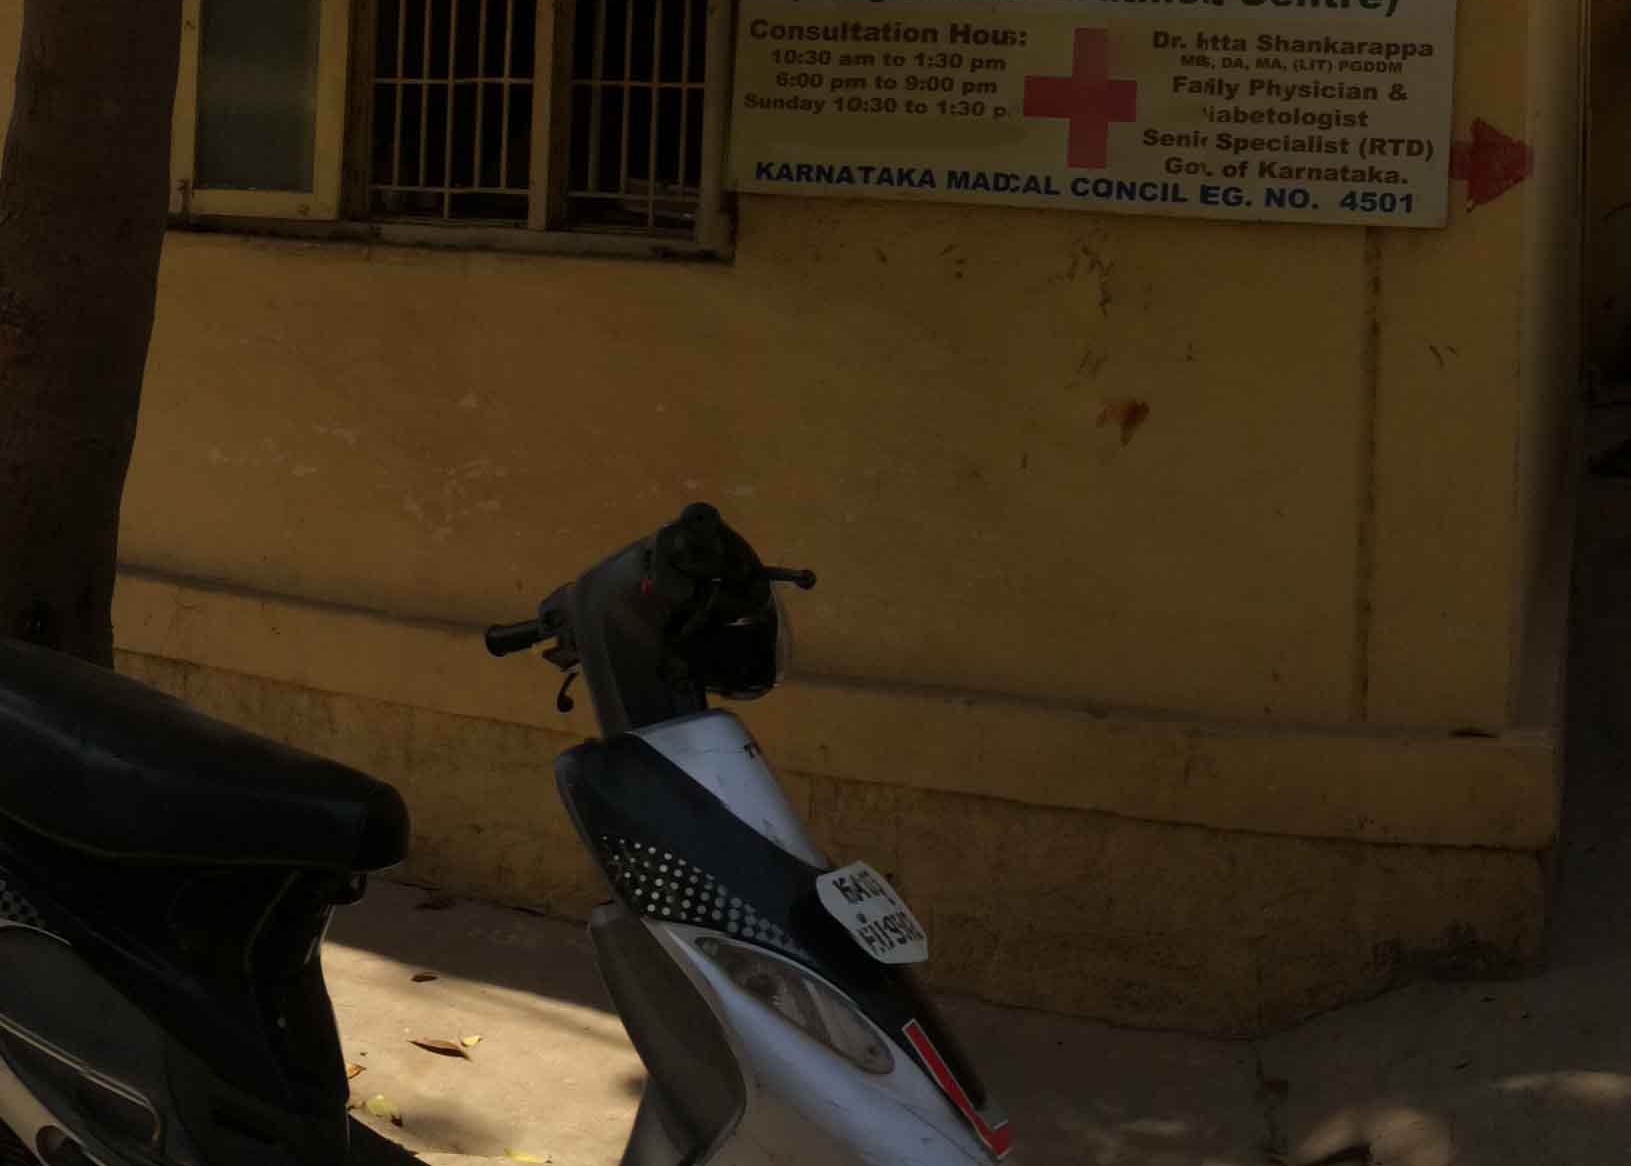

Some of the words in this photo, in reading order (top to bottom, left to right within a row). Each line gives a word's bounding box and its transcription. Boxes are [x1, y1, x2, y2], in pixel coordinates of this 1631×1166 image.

[750, 19, 940, 46] Consultation
[1152, 31, 1187, 51] Dr.
[1255, 34, 1435, 61] Shankarappa
[770, 48, 832, 66] 10:30
[838, 52, 876, 67] am
[881, 51, 907, 67] to
[913, 52, 964, 70] 1:30
[970, 56, 1008, 74] pm
[830, 75, 867, 92] pm
[875, 74, 898, 91] to
[904, 75, 955, 93] 9:00
[962, 80, 998, 96] pm
[1249, 78, 1378, 102] Physician
[1387, 83, 1409, 101] &
[743, 93, 826, 116] Sunday
[833, 95, 898, 114] 10:30
[905, 98, 929, 115] to
[935, 99, 985, 118] 1:30
[1202, 106, 1369, 131] iabetologist
[1215, 132, 1350, 156] Specialist
[1358, 137, 1434, 162] (RTD)
[1222, 160, 1249, 179] of
[1258, 160, 1409, 185] Karnataka.
[755, 161, 936, 190] KARNATAKA
[1264, 187, 1318, 209] NO.
[1339, 190, 1414, 214] 4501
